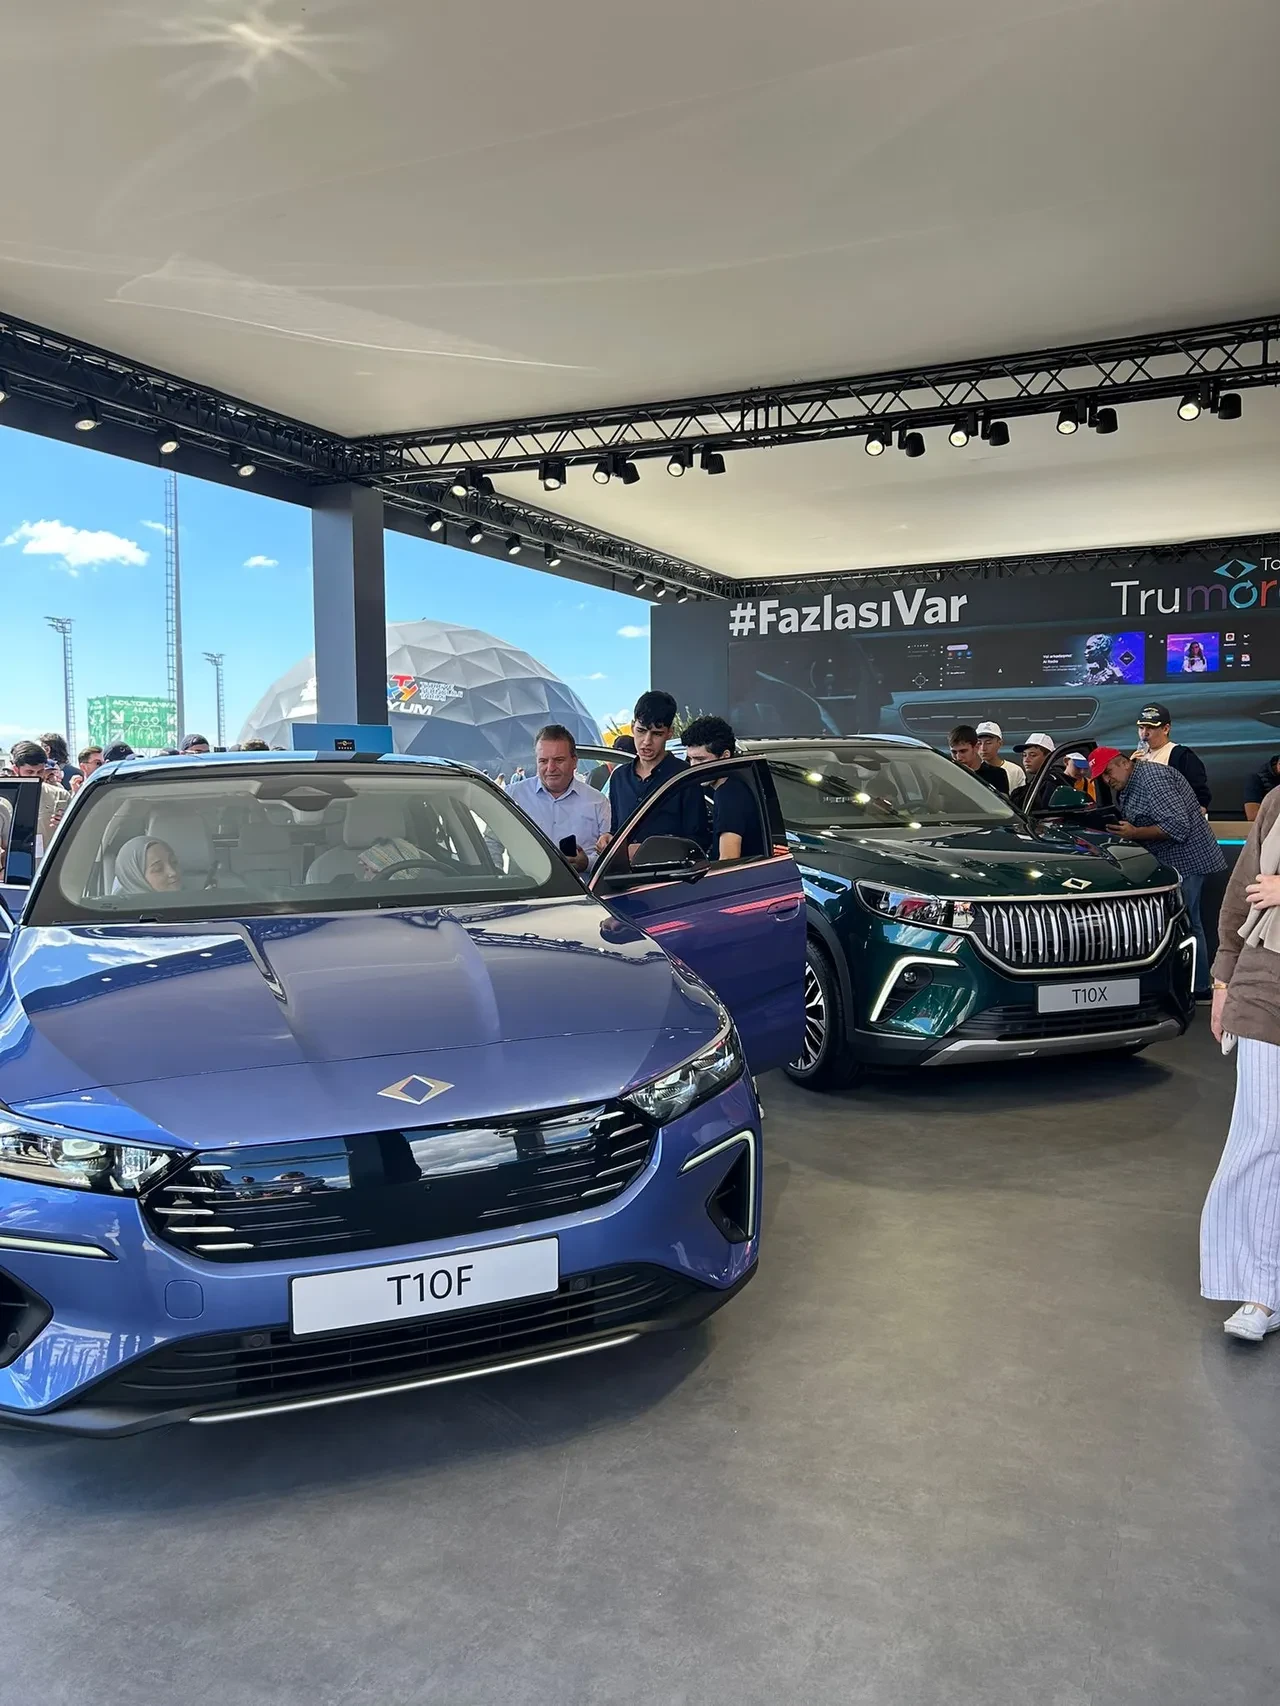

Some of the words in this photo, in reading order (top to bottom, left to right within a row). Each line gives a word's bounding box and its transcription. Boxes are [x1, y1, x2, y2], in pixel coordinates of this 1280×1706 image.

[729, 588, 968, 637] #FazlasıVar
[1110, 579, 1280, 616] Trumor
[1071, 986, 1108, 1004] T10X
[386, 1264, 473, 1306] T10F
